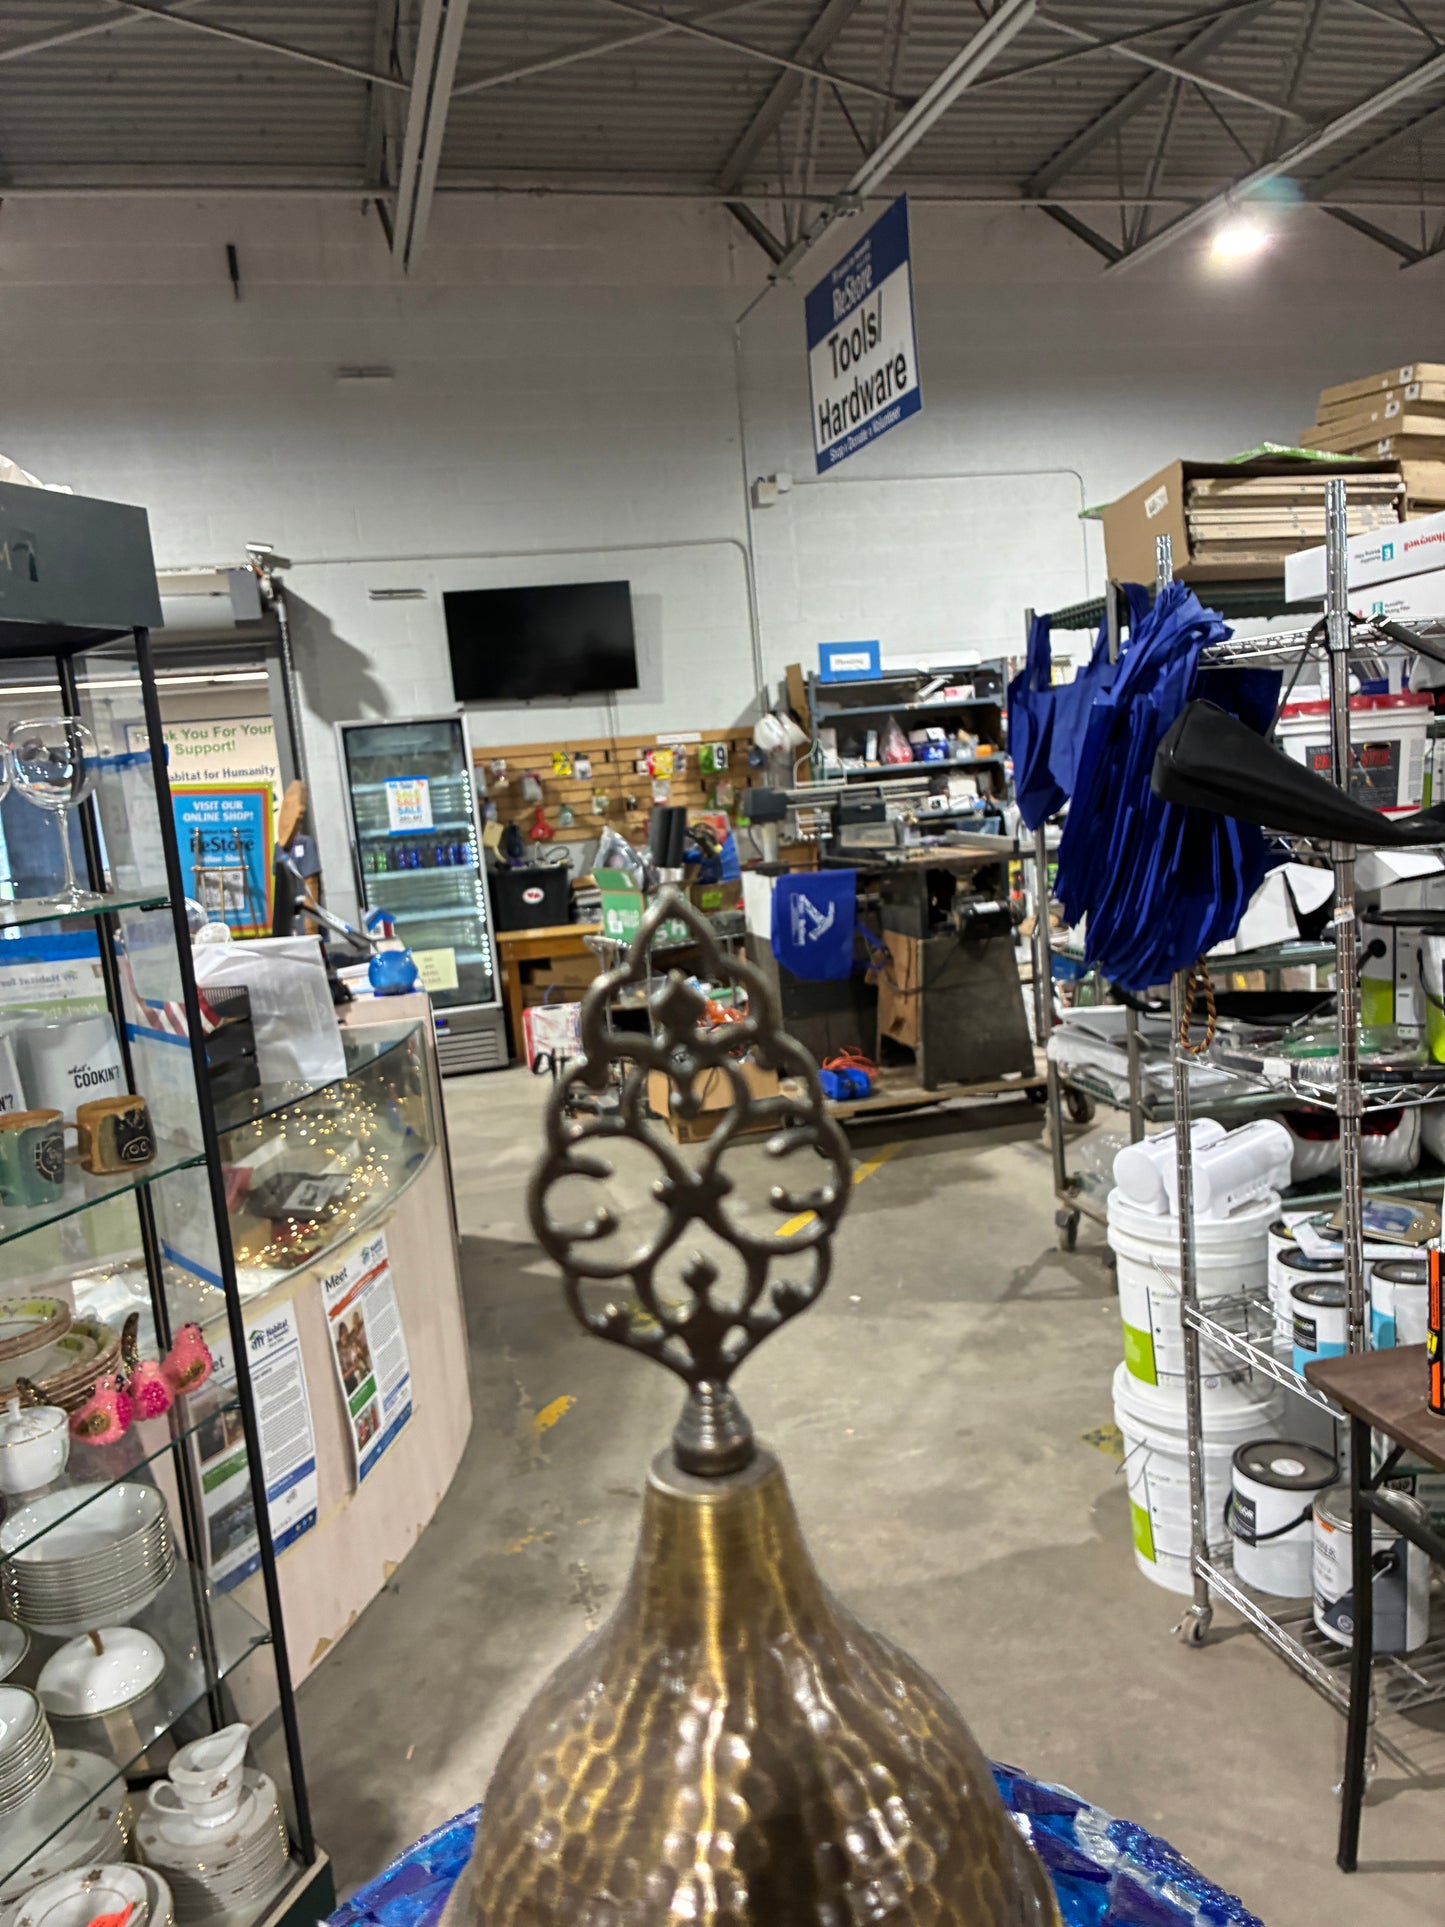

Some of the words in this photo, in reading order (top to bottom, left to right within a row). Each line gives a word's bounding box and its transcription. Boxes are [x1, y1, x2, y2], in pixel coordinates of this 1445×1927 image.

[832, 264, 873, 322] ReStore
[828, 289, 883, 379] Tools/
[818, 352, 908, 445] Hardware
[181, 728, 209, 740] You
[213, 726, 236, 737] For
[241, 724, 273, 736] Your
[174, 740, 236, 756] Support!
[716, 746, 725, 768] 9
[168, 771, 201, 783] abitat
[204, 769, 219, 781] for
[223, 765, 275, 781] Humanity
[183, 812, 220, 822] ONLINE
[222, 810, 254, 821] SHOP!
[193, 801, 219, 811] VISIT
[221, 801, 243, 810] OUR
[67, 1064, 91, 1075] what's
[74, 1065, 120, 1089] COOKIN'?
[325, 1267, 348, 1293] Meet
